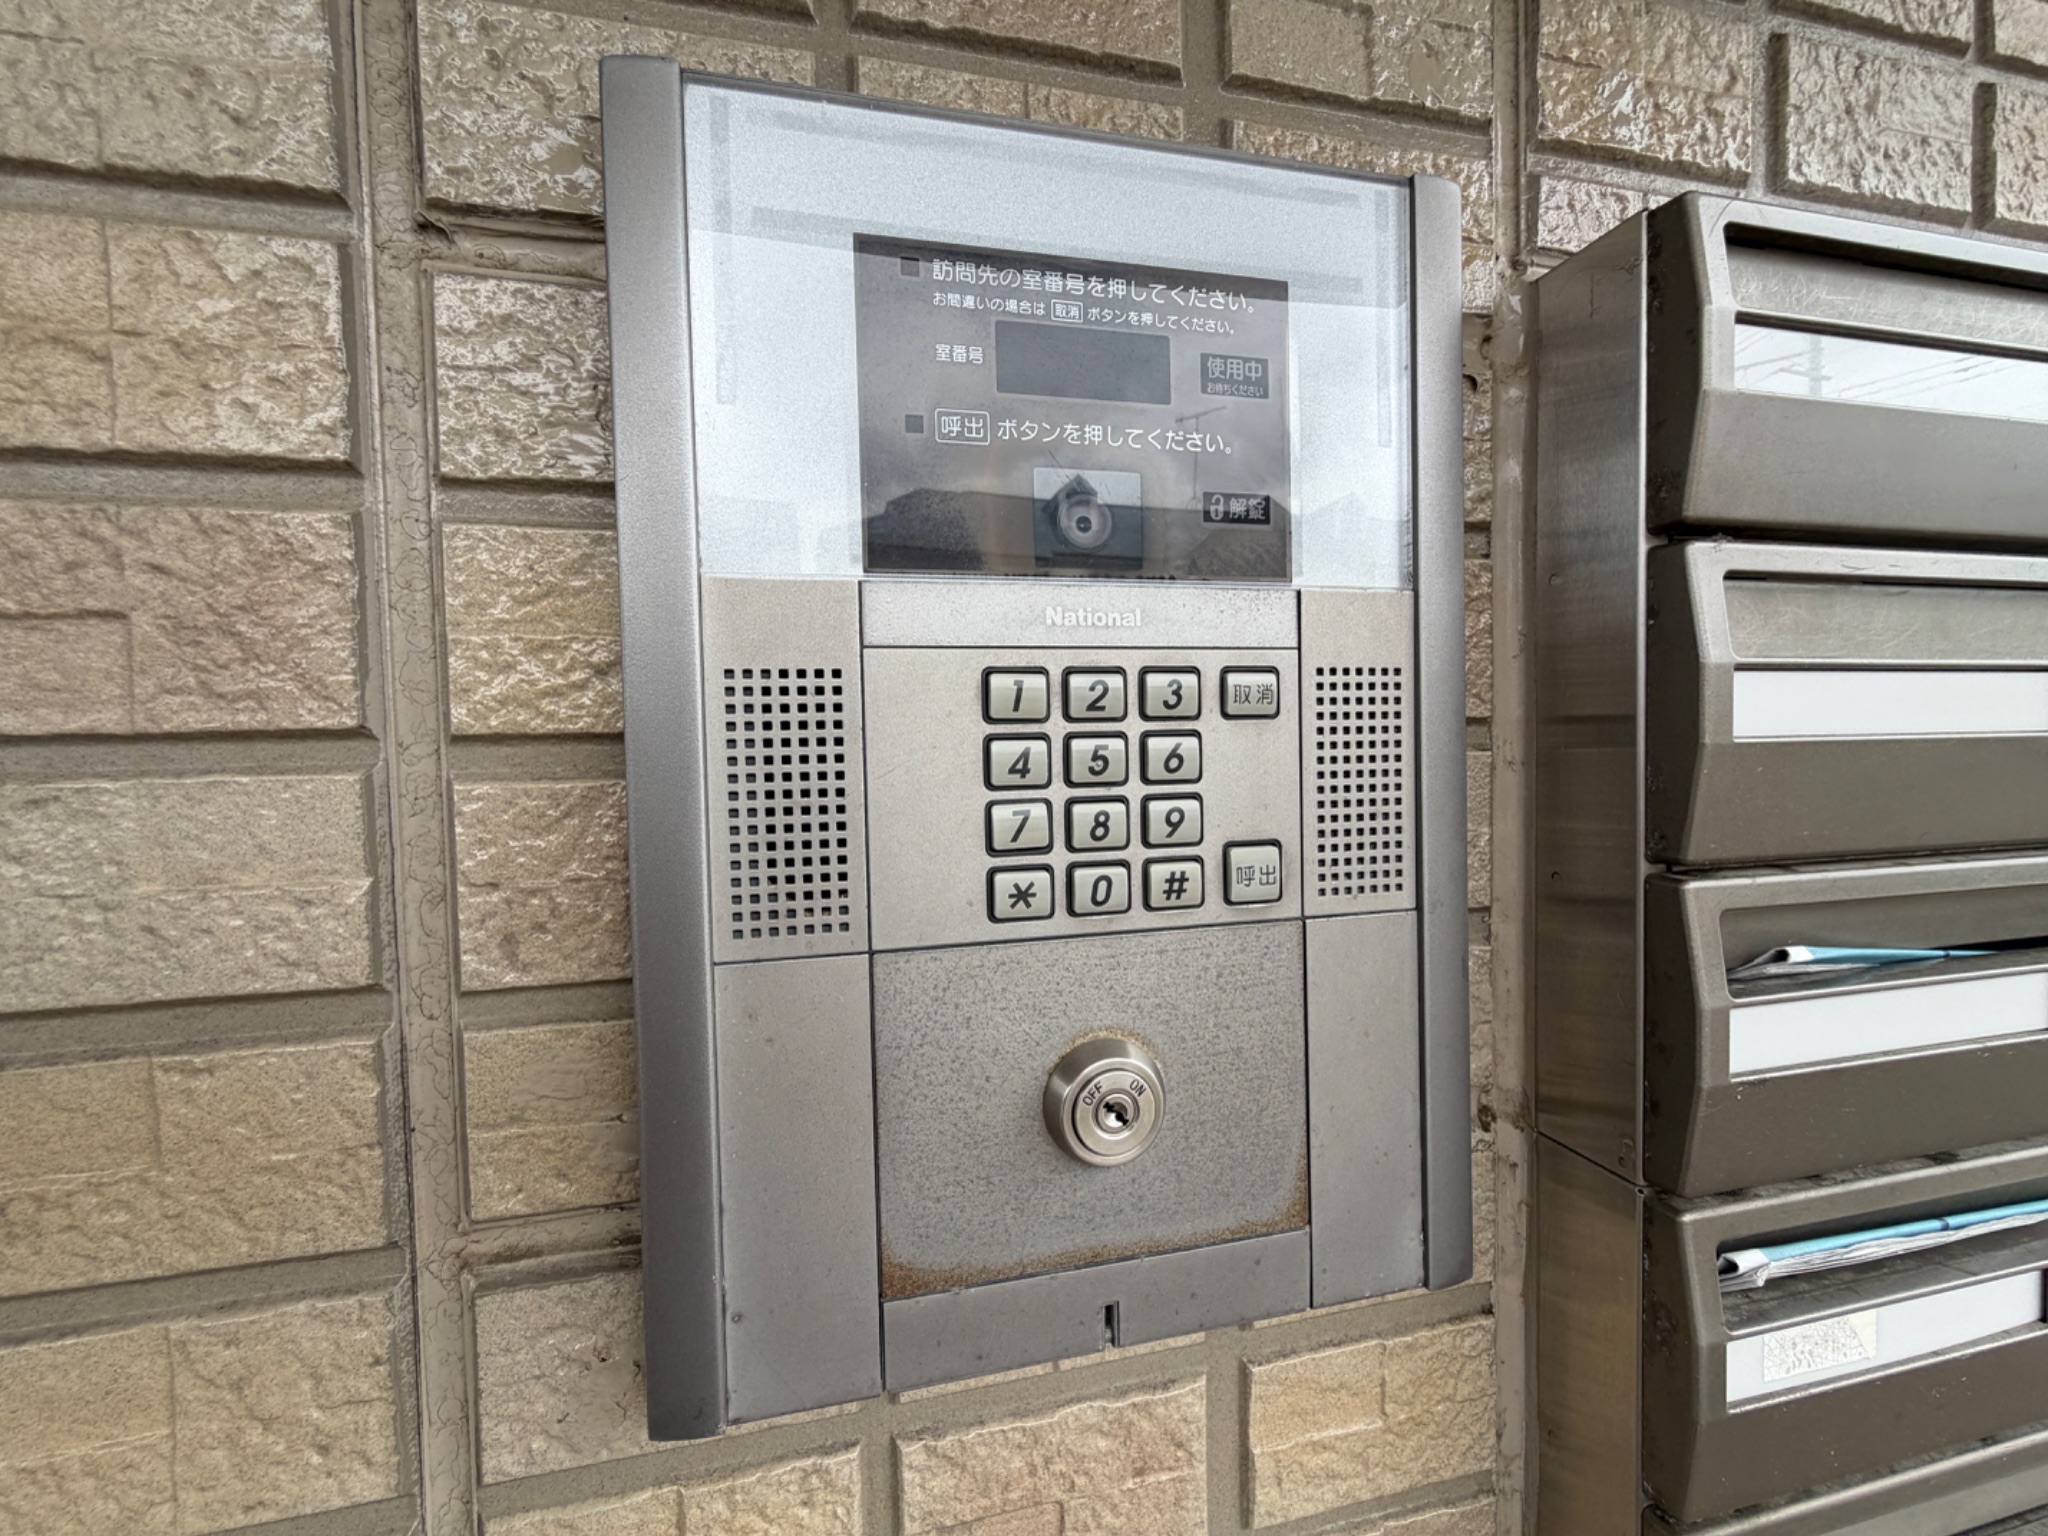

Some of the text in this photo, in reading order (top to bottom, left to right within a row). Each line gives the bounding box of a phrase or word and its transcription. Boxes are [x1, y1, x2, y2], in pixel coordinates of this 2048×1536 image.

[932, 258, 1255, 314] 訪問先の室番号を押してください。
[933, 292, 1235, 336] お間違いの場合は 取消 ボタンを押してください。
[935, 343, 984, 365] 室番号
[1206, 356, 1263, 382] 使用中
[1206, 382, 1264, 398] お待ちください
[941, 416, 1232, 455] 呼出 ボタンを押してください。
[1229, 497, 1266, 521] 解錠
[1045, 606, 1141, 627] National
[1011, 679, 1183, 712] 1 2 3
[1232, 682, 1274, 706] 取消
[1007, 742, 1184, 779] 4 5 6
[1010, 806, 1185, 843] 7 8 9
[1090, 874, 1113, 907] 0
[1162, 870, 1189, 901] #
[1236, 864, 1277, 888] 呼出
[1082, 1078, 1147, 1107] OFF ON
